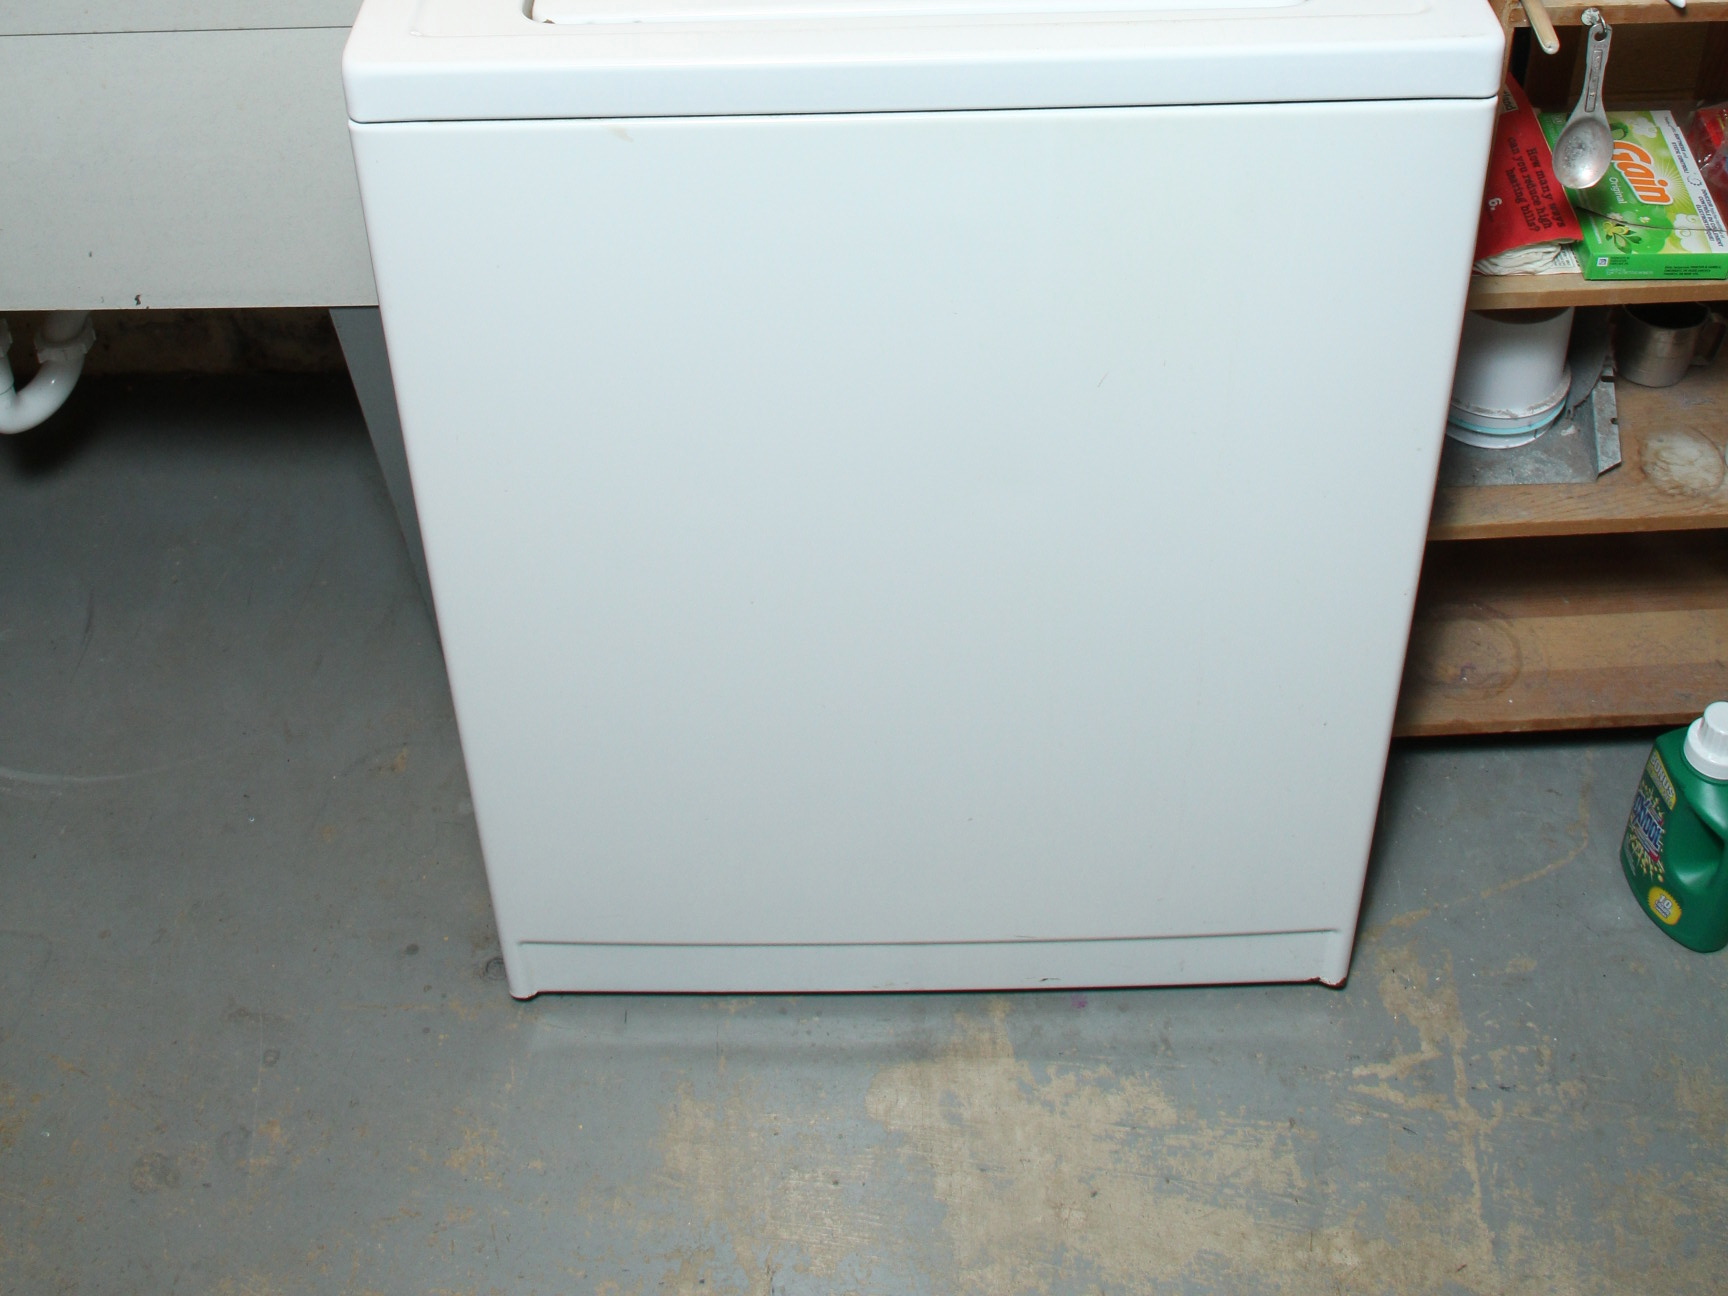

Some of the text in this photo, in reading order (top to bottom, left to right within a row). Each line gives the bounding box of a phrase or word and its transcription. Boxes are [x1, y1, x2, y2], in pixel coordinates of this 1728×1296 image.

[1505, 167, 1540, 232] heating bills?
[1507, 137, 1553, 230] can you reduce high
[1526, 147, 1566, 228] How many ways
[1609, 176, 1627, 204] Original
[1658, 894, 1673, 910] 10
